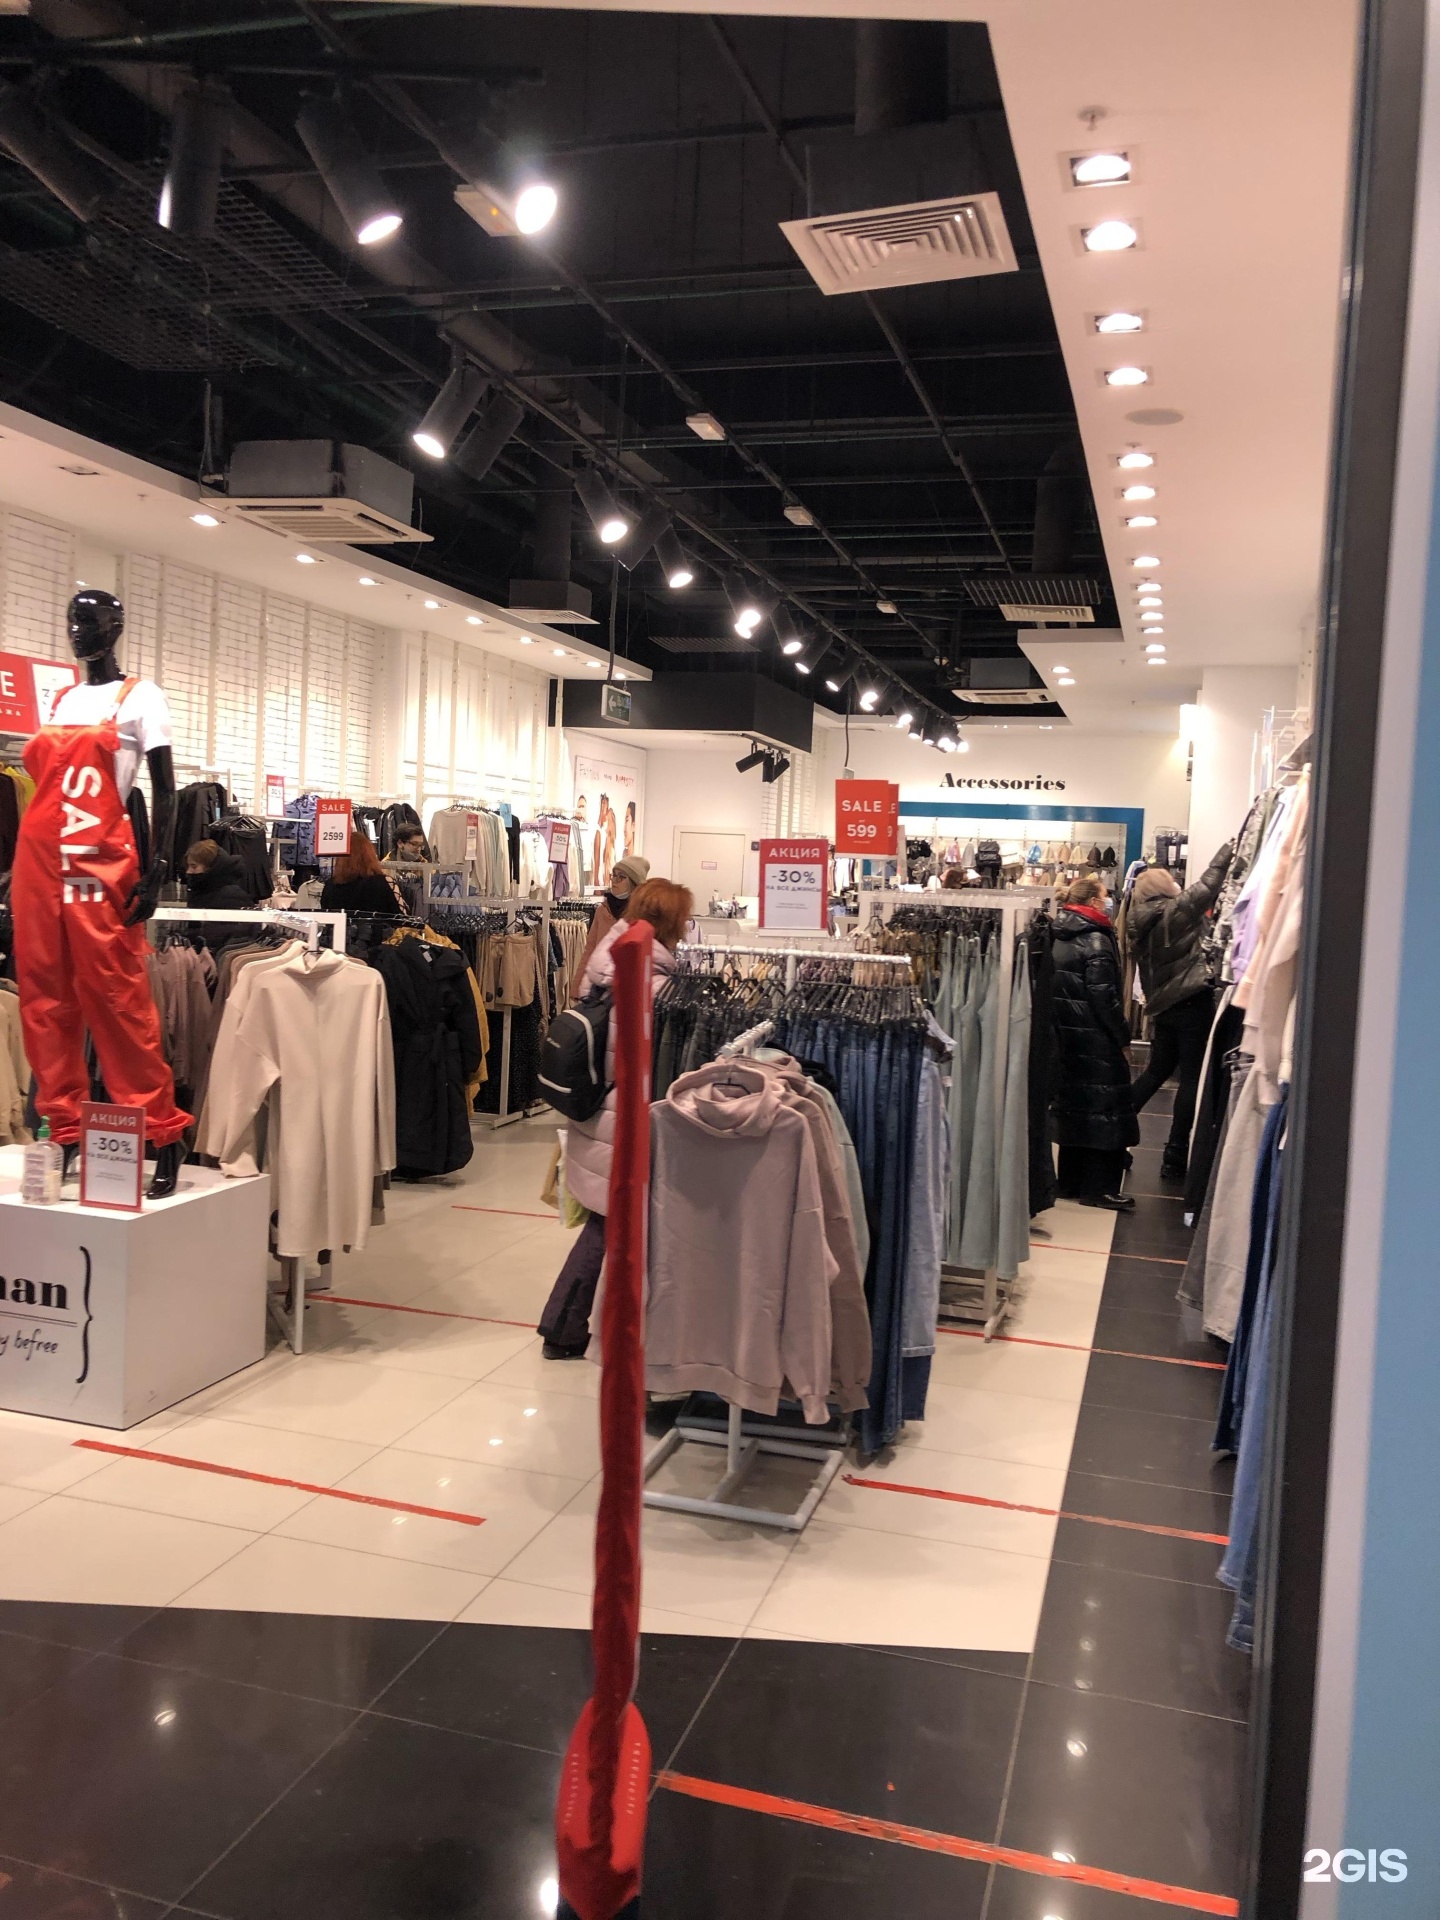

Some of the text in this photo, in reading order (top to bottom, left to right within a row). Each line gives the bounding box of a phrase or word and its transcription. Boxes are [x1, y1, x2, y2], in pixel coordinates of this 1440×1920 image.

[939, 772, 1066, 791] Accessories
[321, 803, 345, 812] SALE
[841, 799, 882, 813] SALE
[60, 765, 103, 904] SALE
[322, 831, 344, 841] 2599
[846, 824, 877, 838] 599
[768, 847, 820, 859] АКЦИЯ
[771, 869, 816, 884] -30%
[89, 1112, 137, 1127] АКЦИЯ
[91, 1137, 132, 1155] -30%
[0, 1274, 70, 1310] an
[14, 1328, 59, 1362] befree
